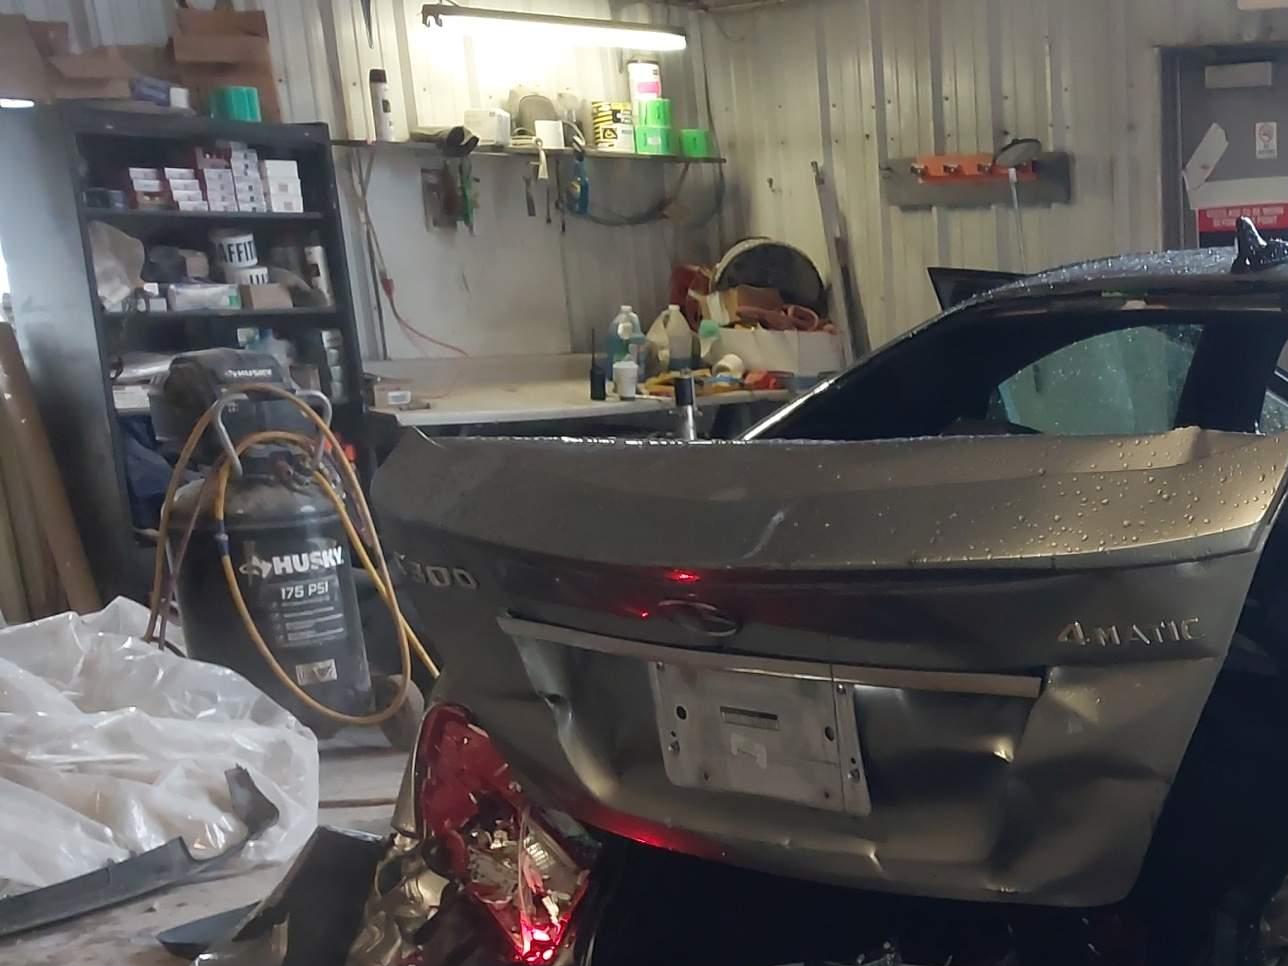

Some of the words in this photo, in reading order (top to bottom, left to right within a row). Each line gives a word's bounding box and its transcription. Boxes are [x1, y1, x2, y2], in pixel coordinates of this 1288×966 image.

[271, 545, 345, 576] HUSKY
[280, 583, 305, 600] 175
[307, 580, 329, 597] PSI
